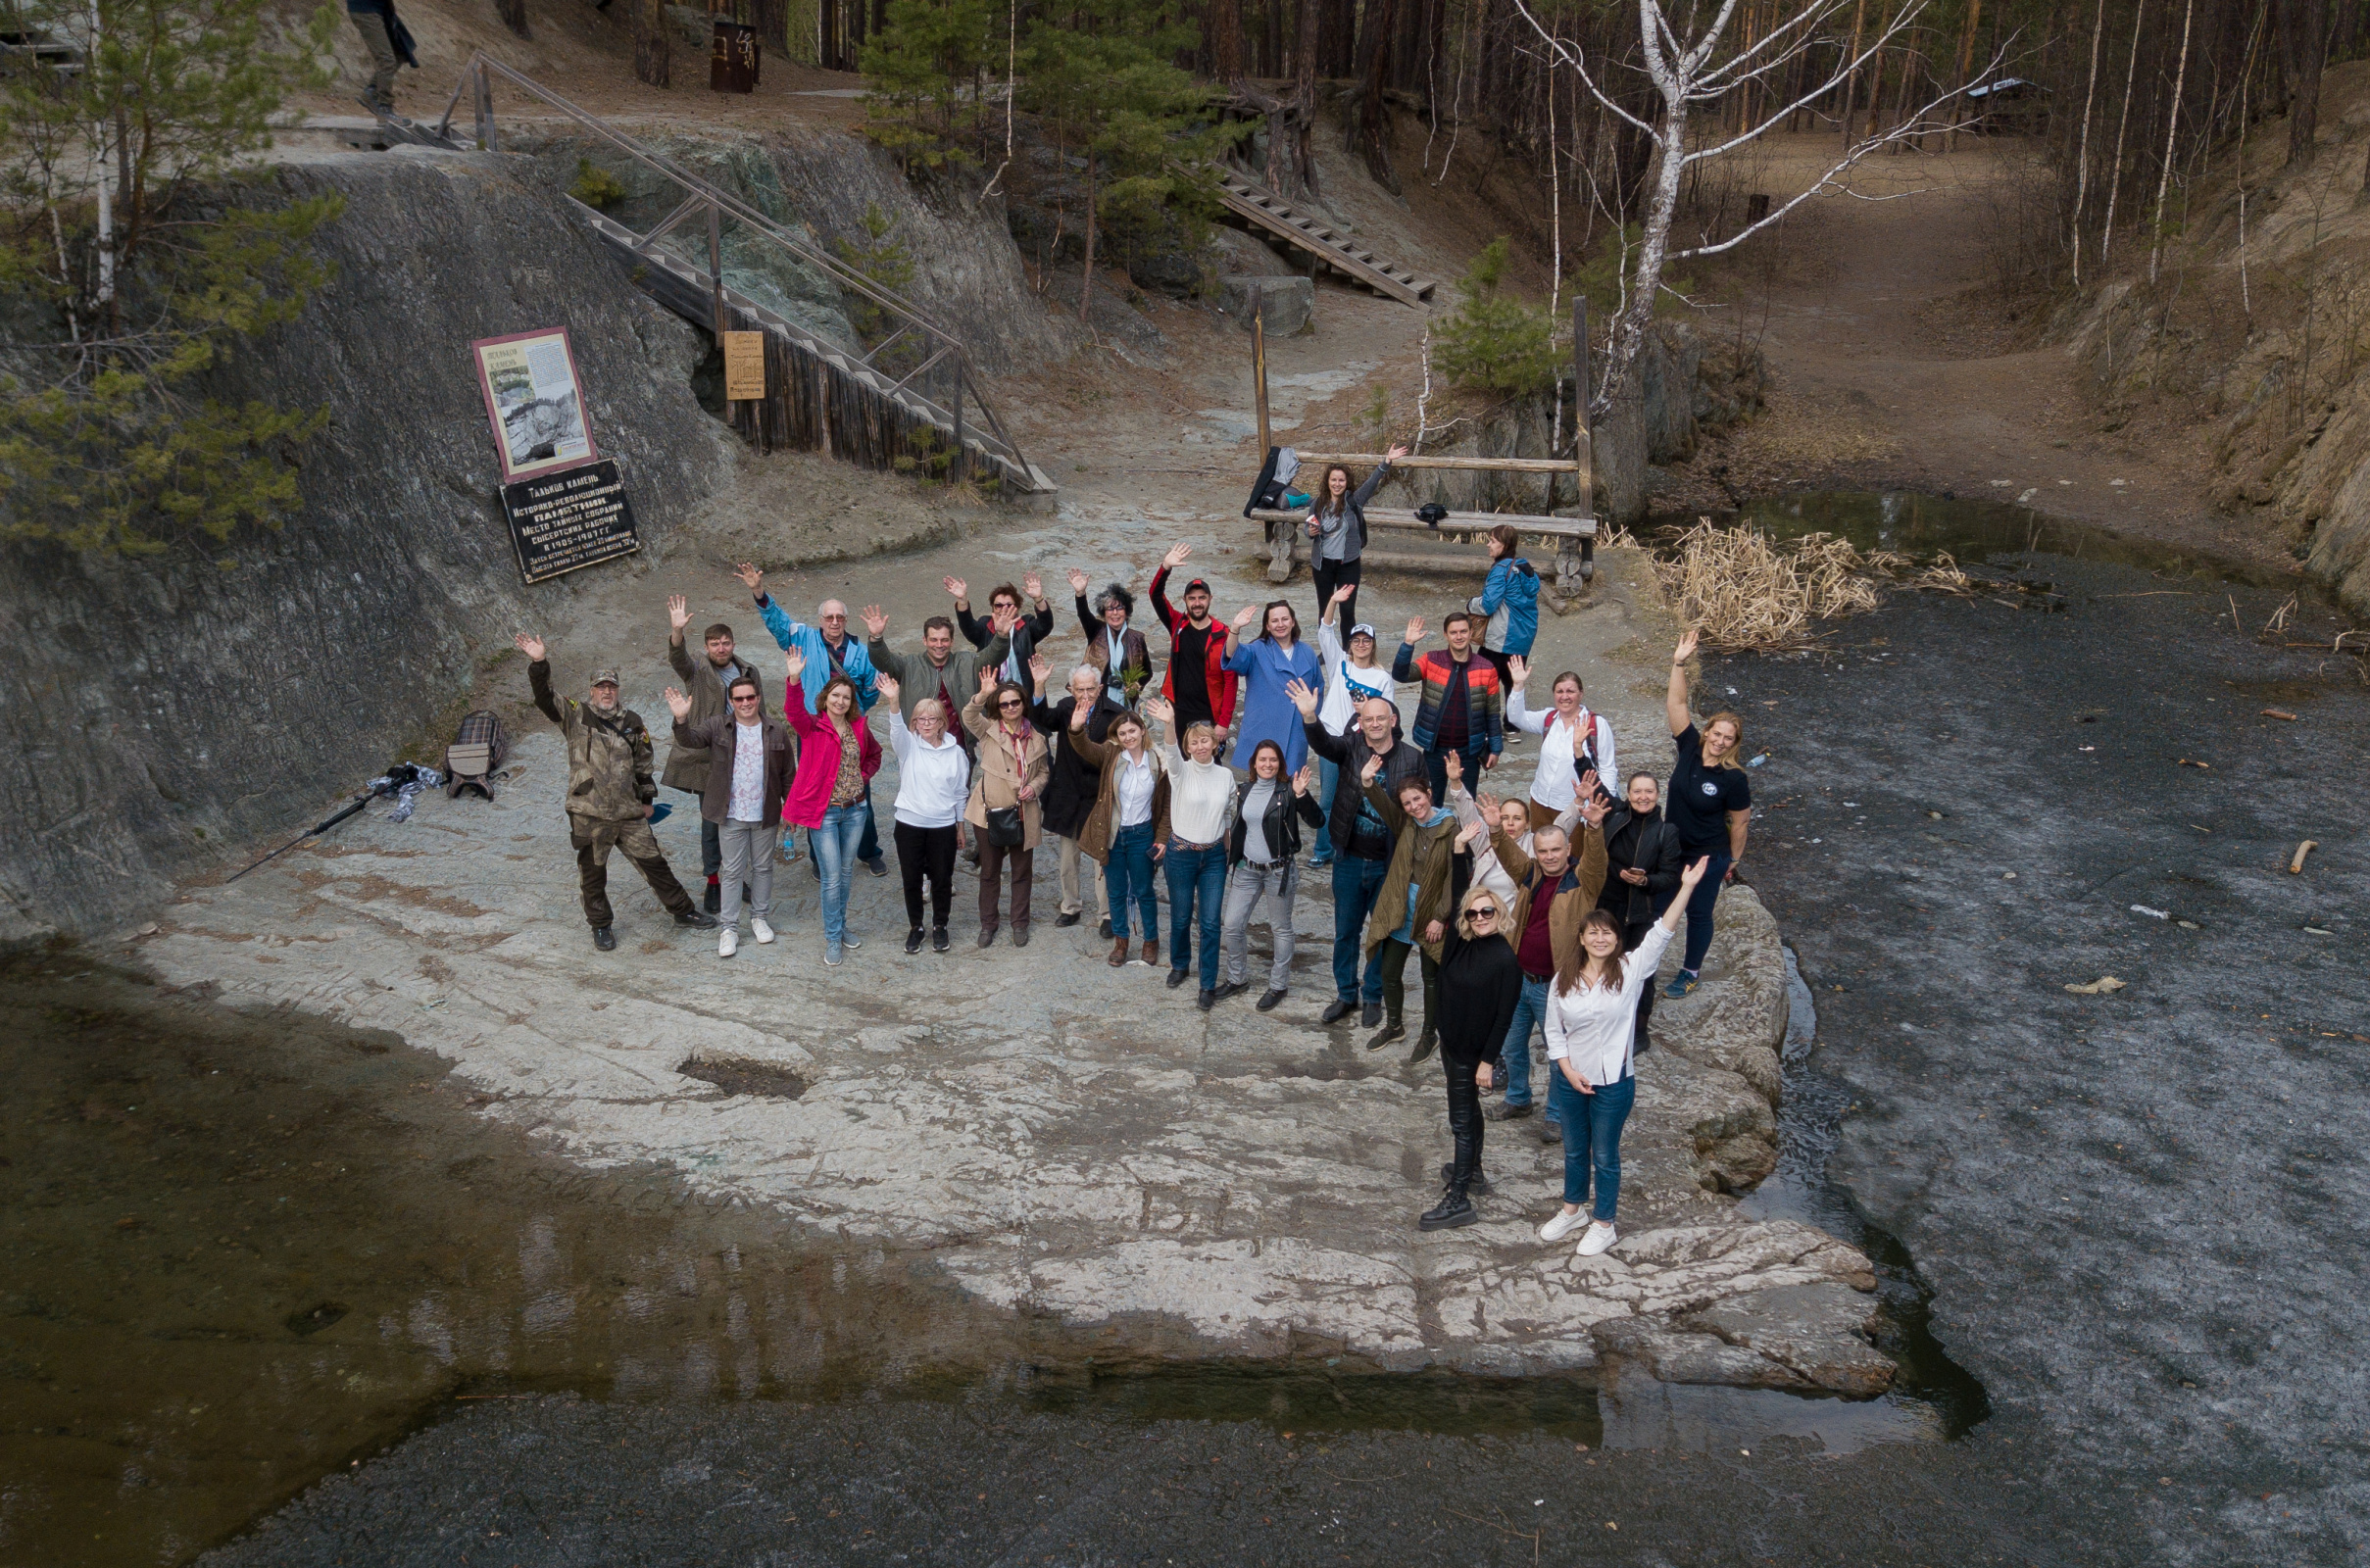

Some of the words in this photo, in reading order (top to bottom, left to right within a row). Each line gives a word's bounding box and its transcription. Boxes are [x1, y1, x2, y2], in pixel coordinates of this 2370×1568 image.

[528, 481, 565, 499] ТАЛЬКОВ
[521, 520, 550, 536] МЕСТО
[552, 513, 583, 527] ТАЙНЫХ
[584, 500, 623, 518] СОБРАНИЙ
[531, 524, 583, 544] СЫСЕРТСКИХ
[584, 514, 618, 529] РАБОЧИХ
